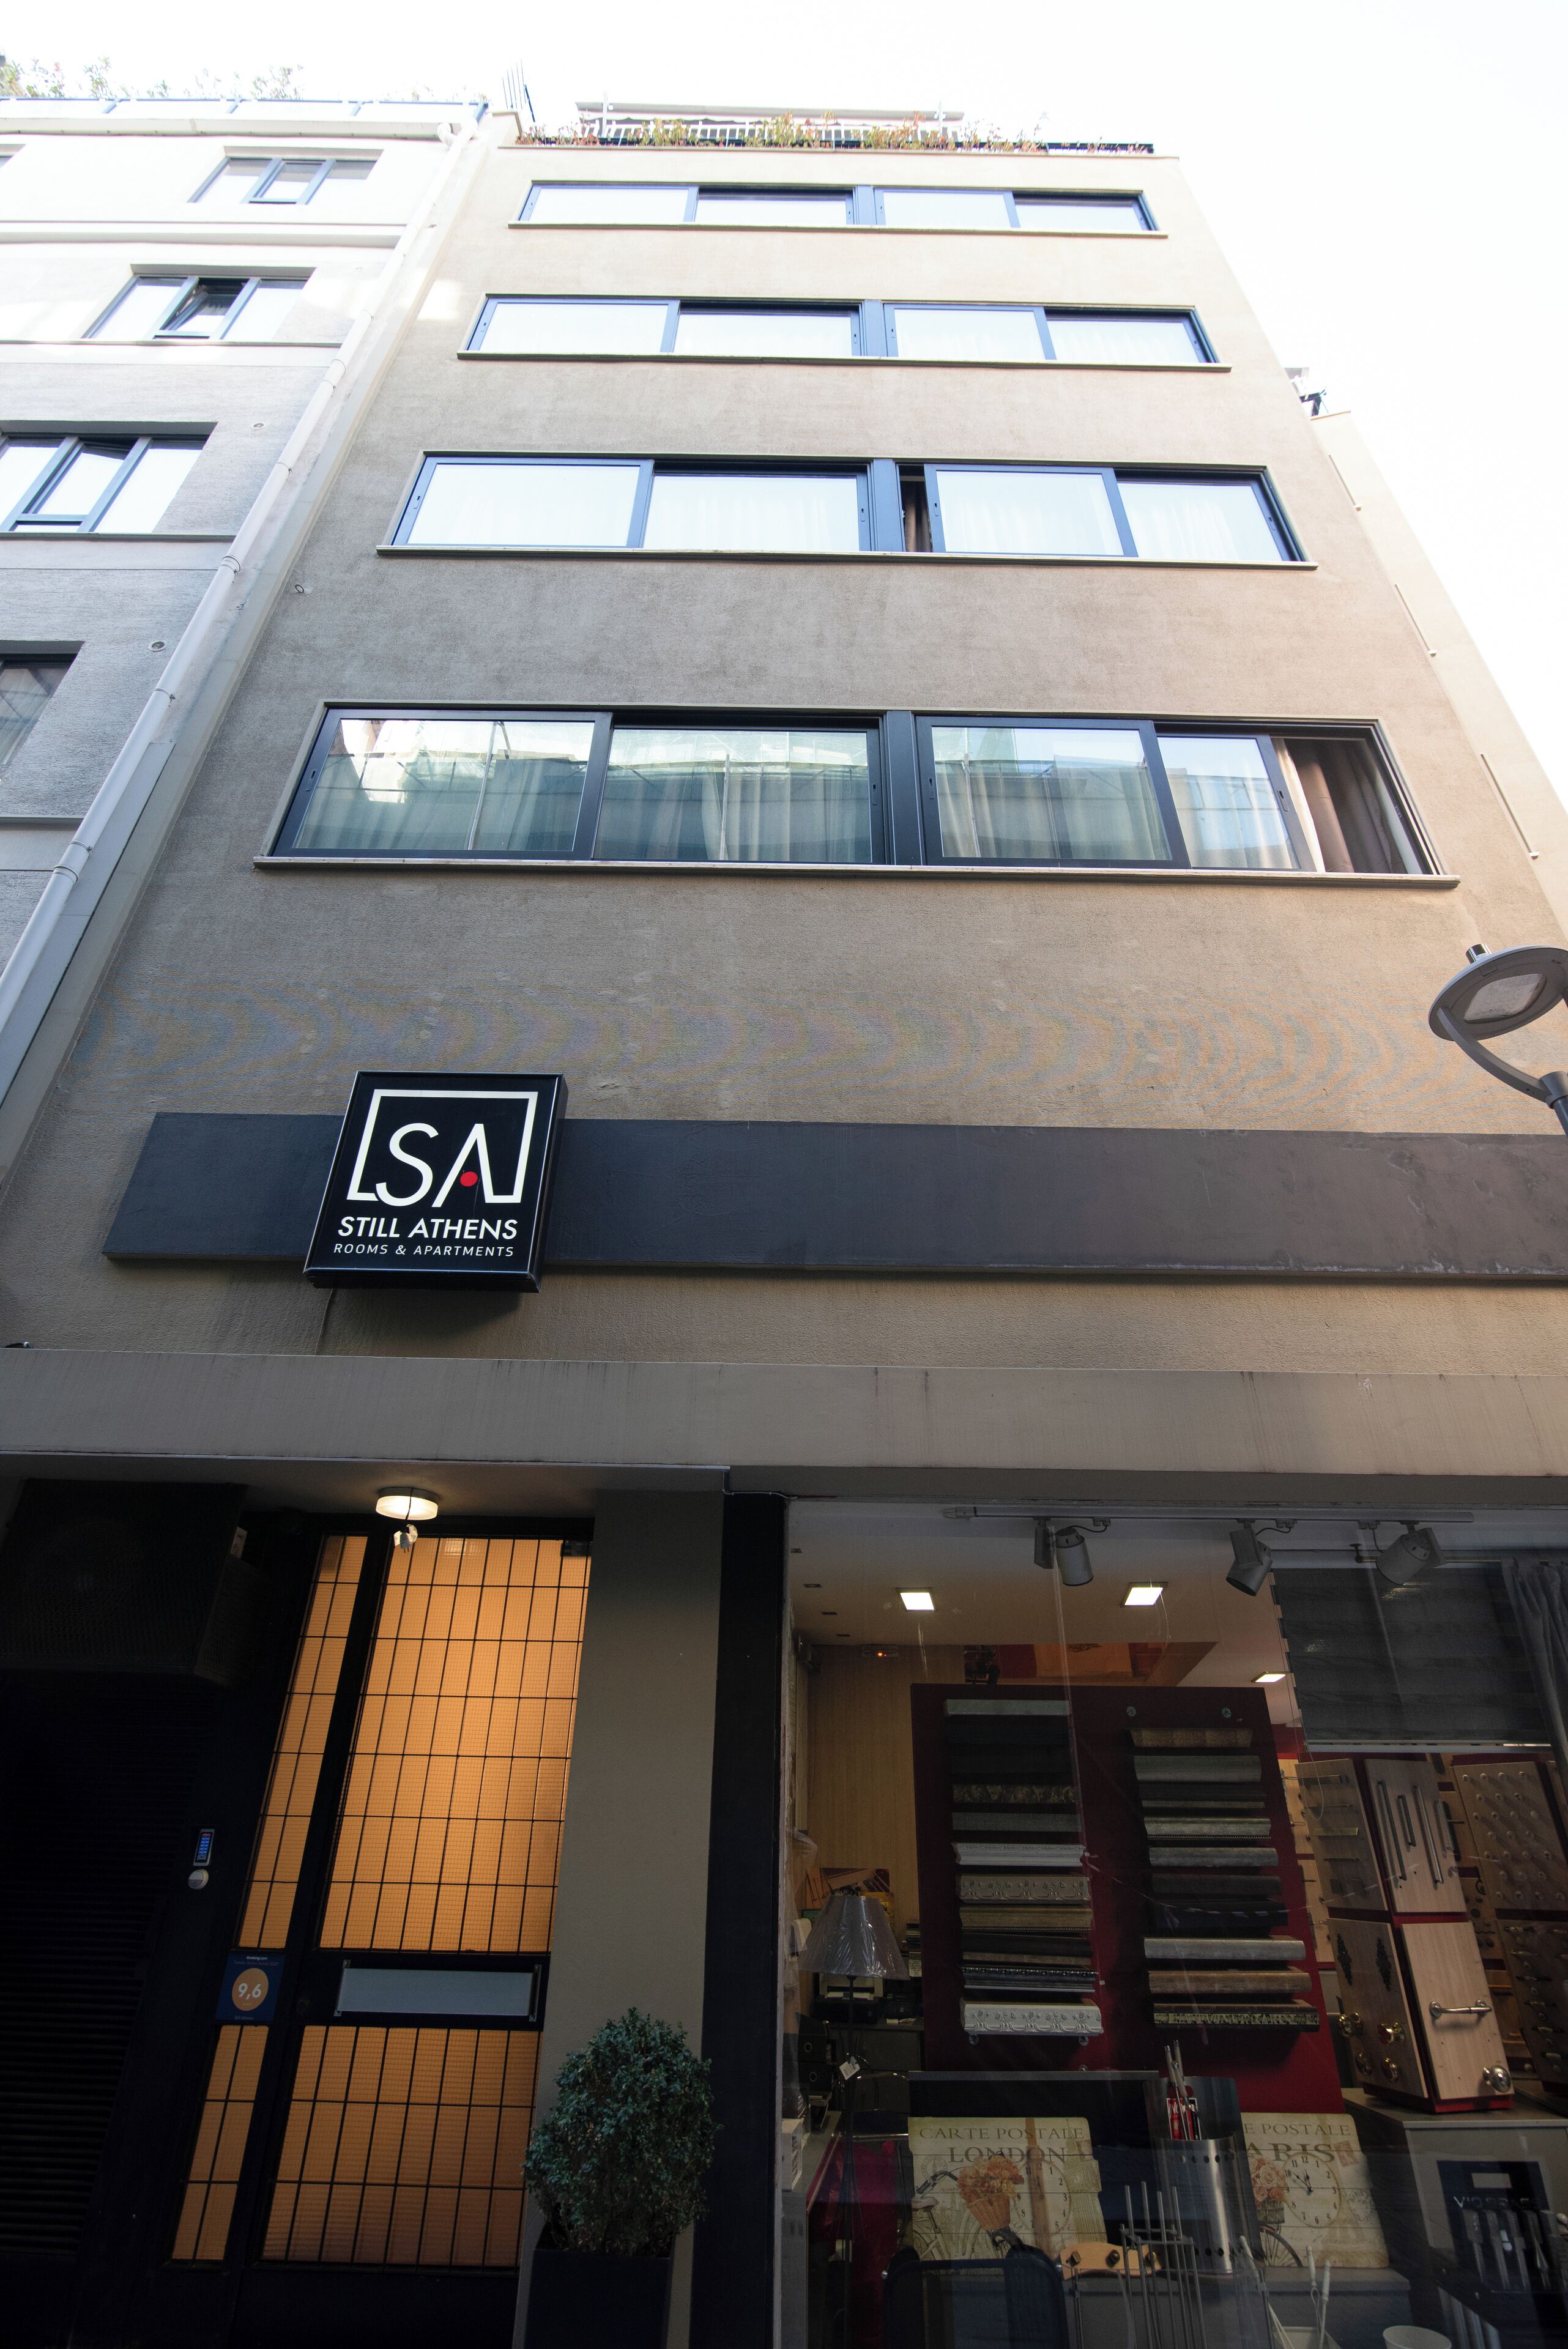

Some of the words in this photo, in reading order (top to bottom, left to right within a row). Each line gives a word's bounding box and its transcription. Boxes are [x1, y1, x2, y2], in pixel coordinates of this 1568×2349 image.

[338, 1216, 401, 1238] STILL
[407, 1219, 518, 1240] ATHENS
[333, 1243, 388, 1255] ROOMS
[395, 1245, 406, 1255] &
[414, 1245, 514, 1256] APARTMENTS
[238, 1983, 262, 2000] 9,6
[919, 2128, 989, 2139] CARTE
[997, 2128, 1085, 2140] POSTALE
[1263, 2123, 1351, 2136] POSTALE
[947, 2147, 1068, 2164] LONDON
[1246, 2142, 1336, 2162] ARIS
[1302, 2155, 1309, 2164] 12
[1285, 2169, 1291, 2177] 10
[1326, 2170, 1331, 2179] 2
[1058, 2177, 1063, 2186] 2
[1063, 2192, 1068, 2202] 3
[1021, 2208, 1025, 2217] 8
[1062, 2209, 1066, 2217] 4
[1301, 2211, 1306, 2221] 7
[1315, 2216, 1320, 2224] 6
[1055, 2221, 1059, 2230] 5
